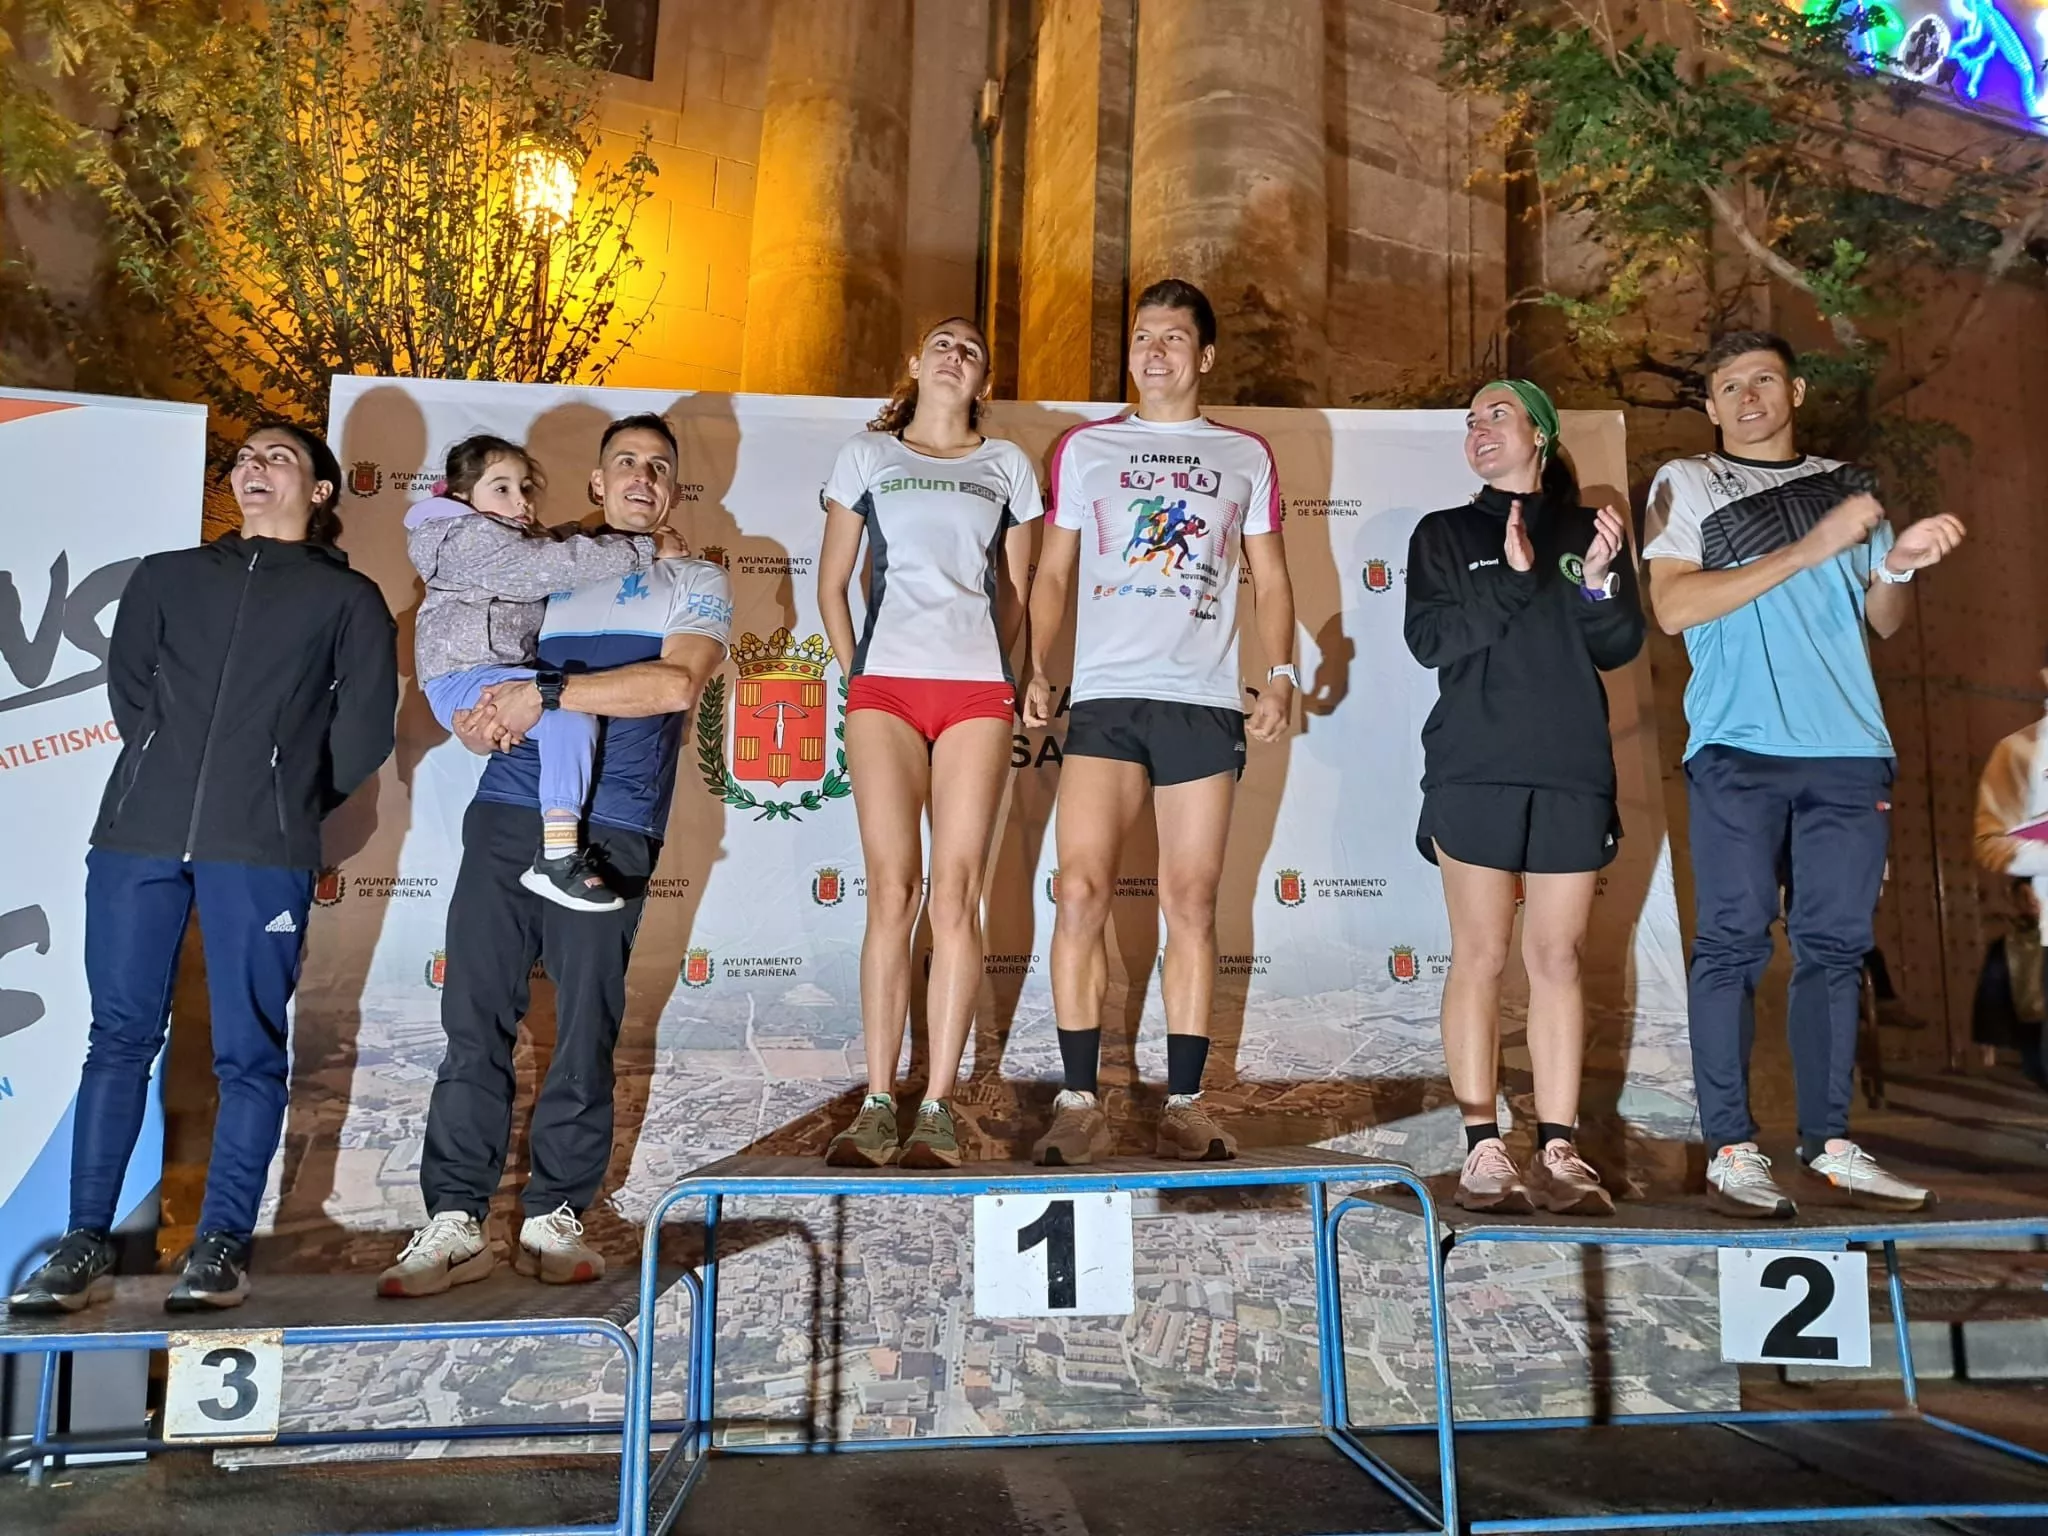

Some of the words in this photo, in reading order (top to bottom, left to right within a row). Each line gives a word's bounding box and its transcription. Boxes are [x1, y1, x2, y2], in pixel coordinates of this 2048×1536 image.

[1142, 453, 1201, 465] CARRERA
[394, 482, 408, 490] DE
[880, 477, 955, 494] sanum
[1292, 499, 1362, 508] AYUNTAMIENTO
[1312, 507, 1358, 517] SARIÑENA
[737, 556, 812, 566] AYUNTAMIENTO
[741, 566, 755, 574] DE
[758, 566, 807, 575] SARIÑENA
[354, 877, 439, 887] AYUNTAMIENTO
[650, 879, 690, 888] MIENTO
[1115, 878, 1158, 886] AMIENTO
[1313, 878, 1387, 887] AYUNTAMIENTO
[359, 888, 373, 897] DE
[376, 887, 431, 898] SARIÑENA
[1318, 889, 1331, 897] DE
[1334, 887, 1383, 898] SARIÑENA
[722, 957, 802, 967] AYUNTAMIENTO
[984, 954, 1040, 963] NTAMIENTO
[727, 969, 741, 978] DE
[744, 967, 797, 978] SARIÑENA
[985, 965, 1036, 975] SARIÑENA
[1432, 965, 1445, 974] DE
[1017, 1199, 1077, 1309] 1
[1760, 1256, 1838, 1360] 2
[197, 1347, 259, 1421] 3
